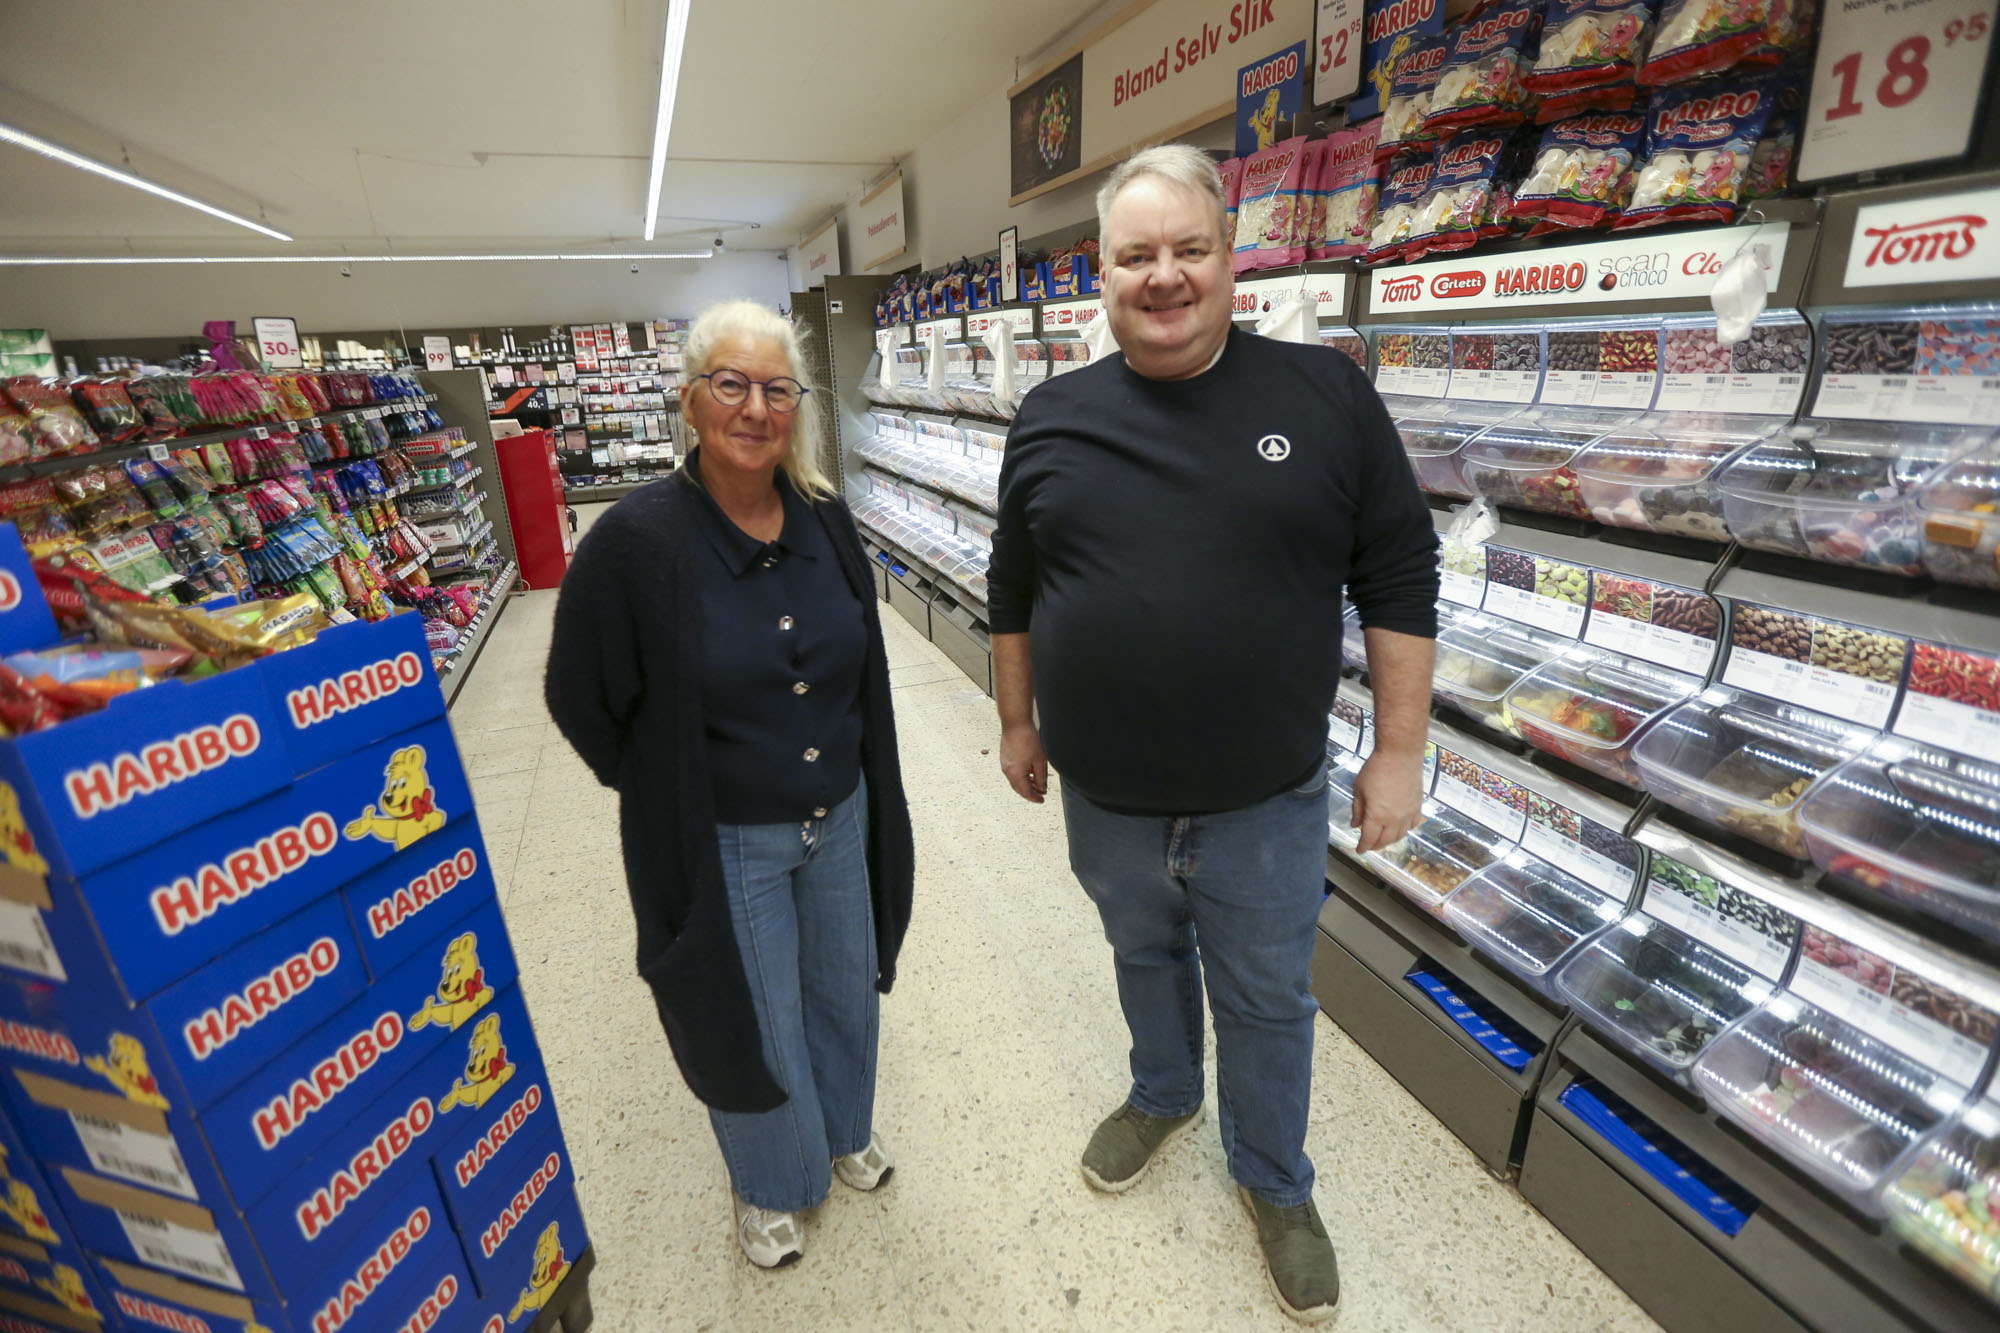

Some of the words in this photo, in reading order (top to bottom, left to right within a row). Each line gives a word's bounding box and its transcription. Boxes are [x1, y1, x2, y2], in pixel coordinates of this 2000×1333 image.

[1113, 47, 1169, 107] Bland
[1174, 23, 1222, 73] Selv
[1228, 0, 1274, 44] Slik
[1320, 28, 1349, 72] 32
[1350, 17, 1361, 36] 95
[1367, 0, 1435, 43] HARIBO
[1243, 51, 1298, 97] HARIBO
[1824, 35, 1931, 122] 18
[1943, 11, 1988, 47] 95
[1553, 115, 1645, 136] HARIBO
[1657, 90, 1760, 133] HARIBO
[1246, 150, 1296, 178] HARIBO
[1864, 215, 1988, 267] Toms
[1231, 292, 1257, 313] RIBO
[1261, 288, 1292, 302] scan
[1380, 274, 1425, 304] Toms
[1433, 275, 1482, 296] Carletti
[1493, 262, 1586, 297] HARIBO
[1597, 252, 1670, 275] scan
[1619, 269, 1668, 288] choco
[290, 655, 420, 725] HARIBO
[71, 718, 256, 813] HARIBO
[156, 815, 334, 930] HARIBO
[370, 850, 475, 937] HARIBO
[188, 940, 336, 1055] HARIBO
[0, 1019, 78, 1064] ARIBO
[256, 1014, 401, 1146] HARIBO
[300, 1100, 432, 1236] HARIBO
[457, 1086, 541, 1185] HARIBO
[482, 1154, 559, 1256] HARIBO
[315, 1209, 429, 1333] HARIBO
